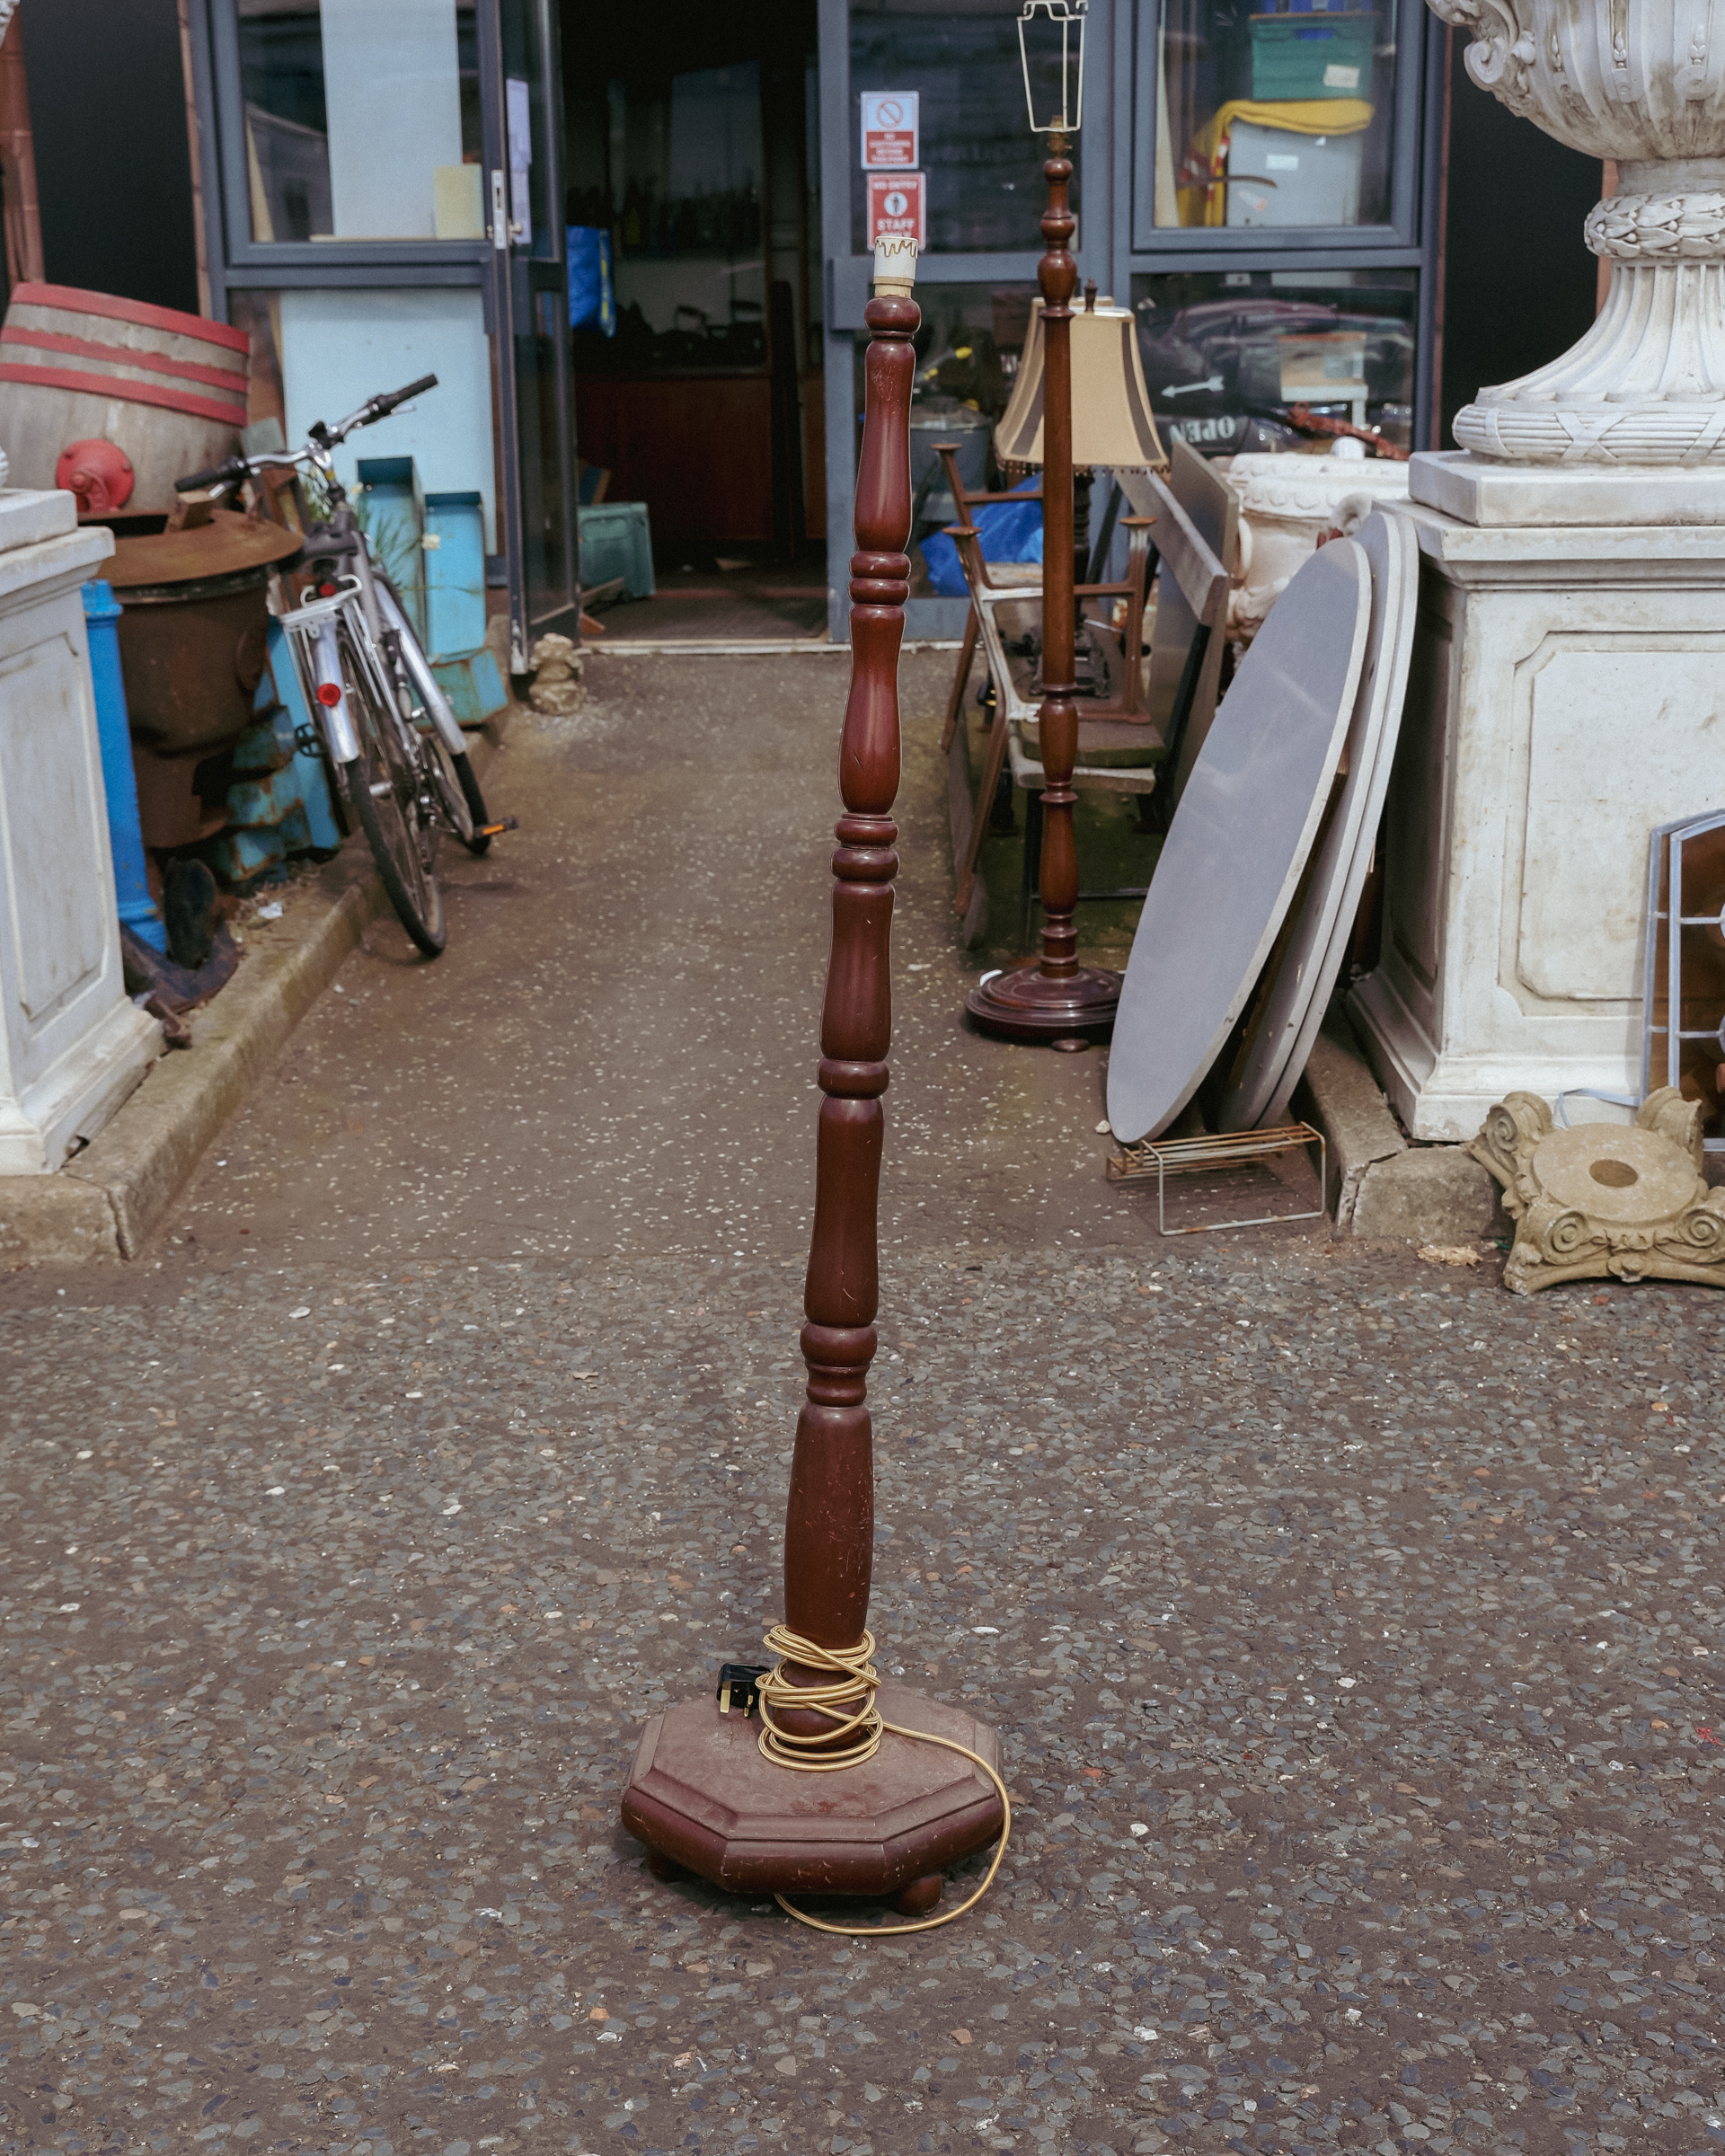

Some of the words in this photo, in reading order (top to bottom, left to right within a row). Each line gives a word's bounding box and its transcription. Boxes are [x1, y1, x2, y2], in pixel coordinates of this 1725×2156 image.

[873, 181, 887, 190] NO
[889, 181, 917, 190] ENTRY
[877, 218, 915, 231] STAFF
[1170, 416, 1236, 443] OPEN
